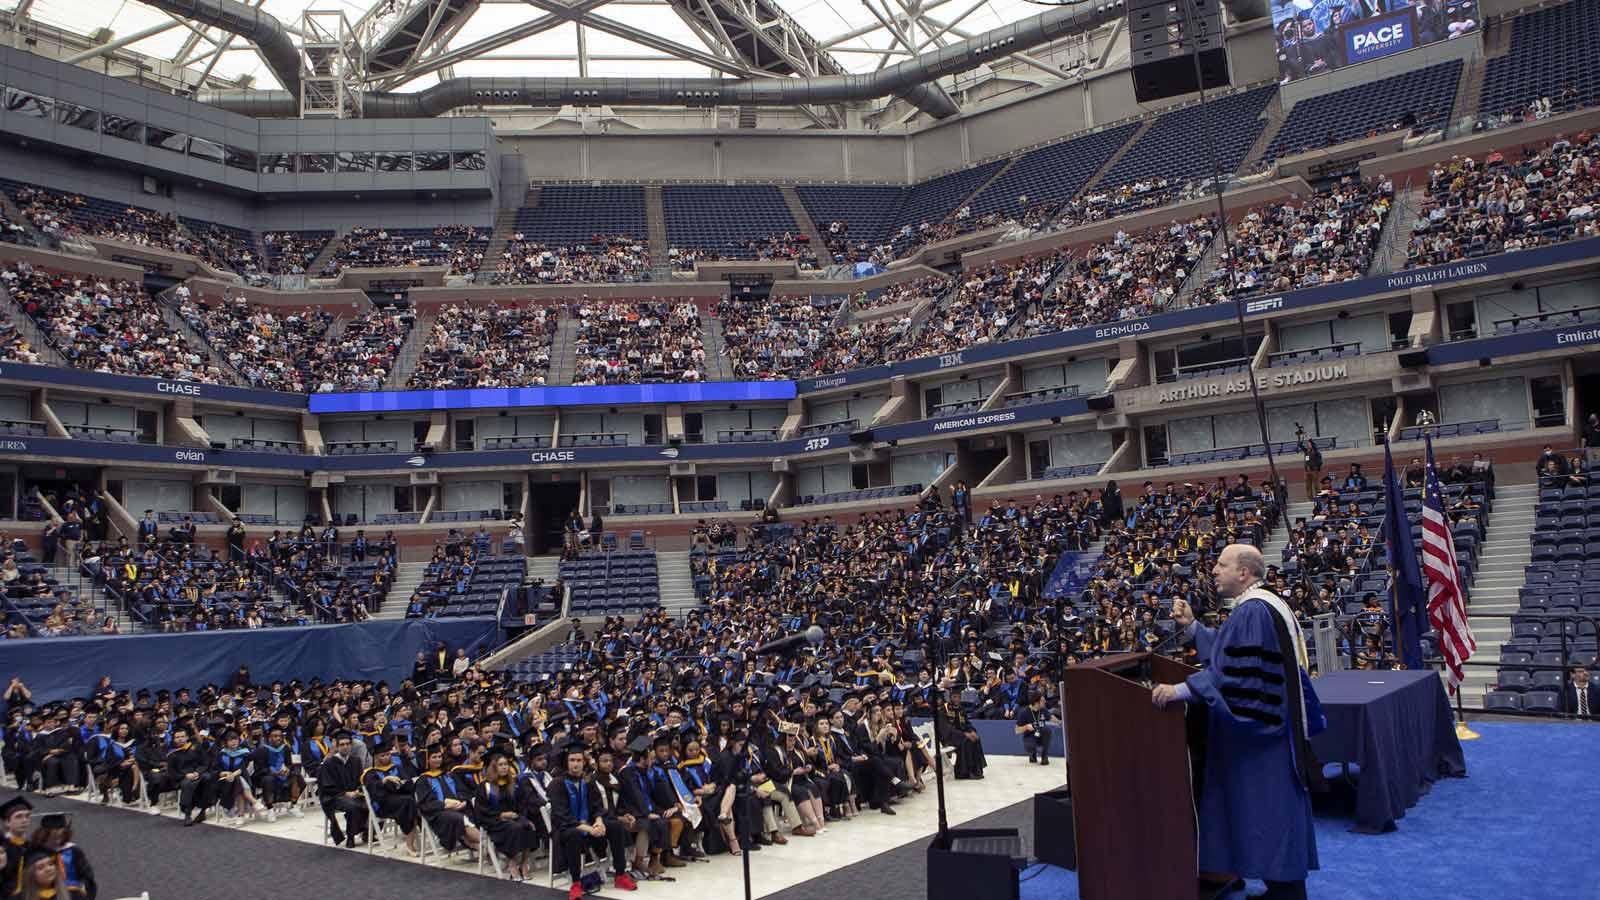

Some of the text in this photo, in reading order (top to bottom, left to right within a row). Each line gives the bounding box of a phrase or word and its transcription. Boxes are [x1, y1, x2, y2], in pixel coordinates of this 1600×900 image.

[1353, 23, 1403, 50] PACE
[1356, 39, 1401, 55] UNIVERSITY
[1387, 263, 1488, 288] POLO RALPH LAUREN
[1246, 297, 1283, 312] ESPN
[1096, 322, 1150, 338] BERMUDA
[939, 353, 963, 368] IBM
[157, 382, 200, 395] CHASE
[1160, 384, 1220, 404] ARTHUR
[1273, 365, 1348, 387] STADIUM
[934, 412, 1015, 432] AMERICAN EXPRESS
[804, 437, 829, 450] ATP
[176, 450, 204, 461] evian
[531, 451, 575, 462] CHASE
